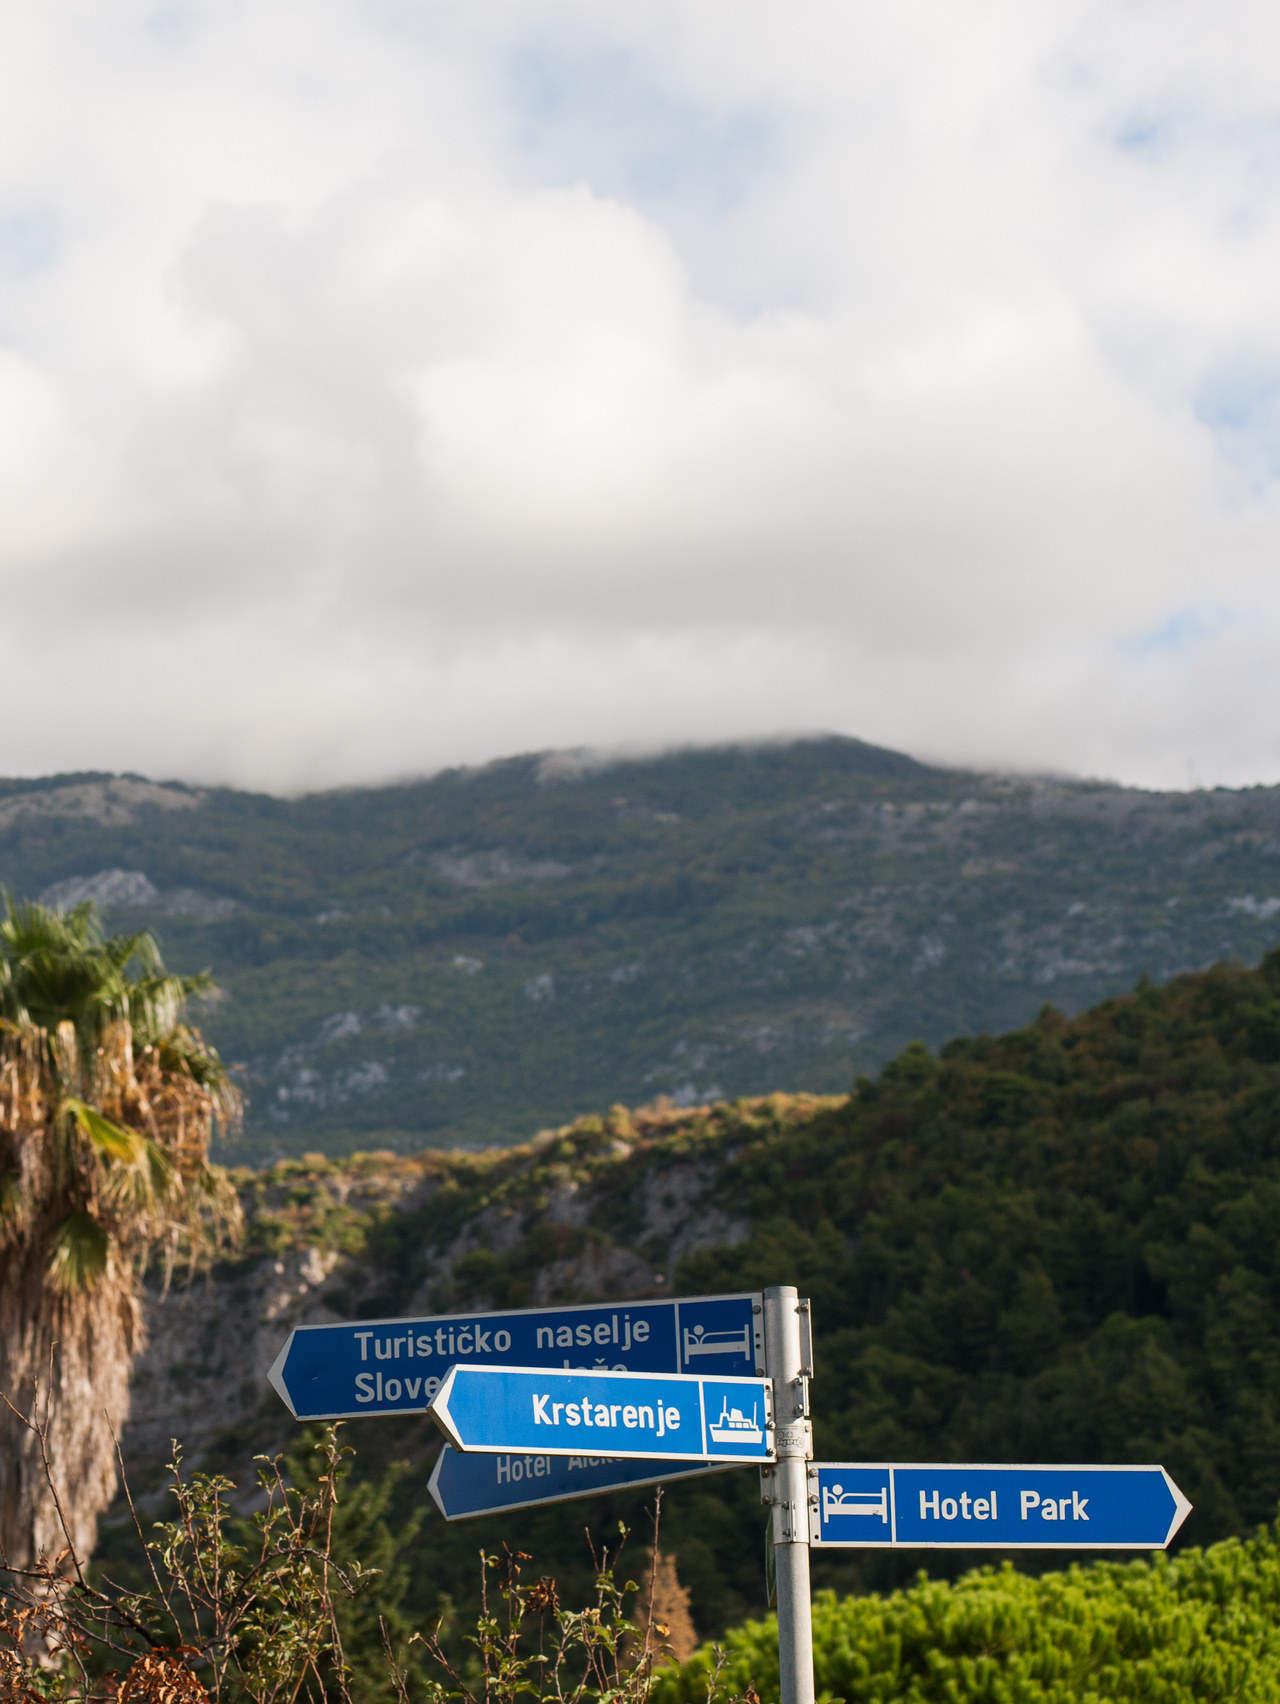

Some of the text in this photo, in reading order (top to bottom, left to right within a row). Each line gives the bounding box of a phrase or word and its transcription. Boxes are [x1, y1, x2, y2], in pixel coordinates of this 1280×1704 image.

[354, 1314, 650, 1361] Turističko naselje
[354, 1371, 441, 1403] Slove
[532, 1394, 681, 1437] Krstarenje
[496, 1454, 551, 1485] Hotel
[919, 1490, 1090, 1520] Hotel Park
